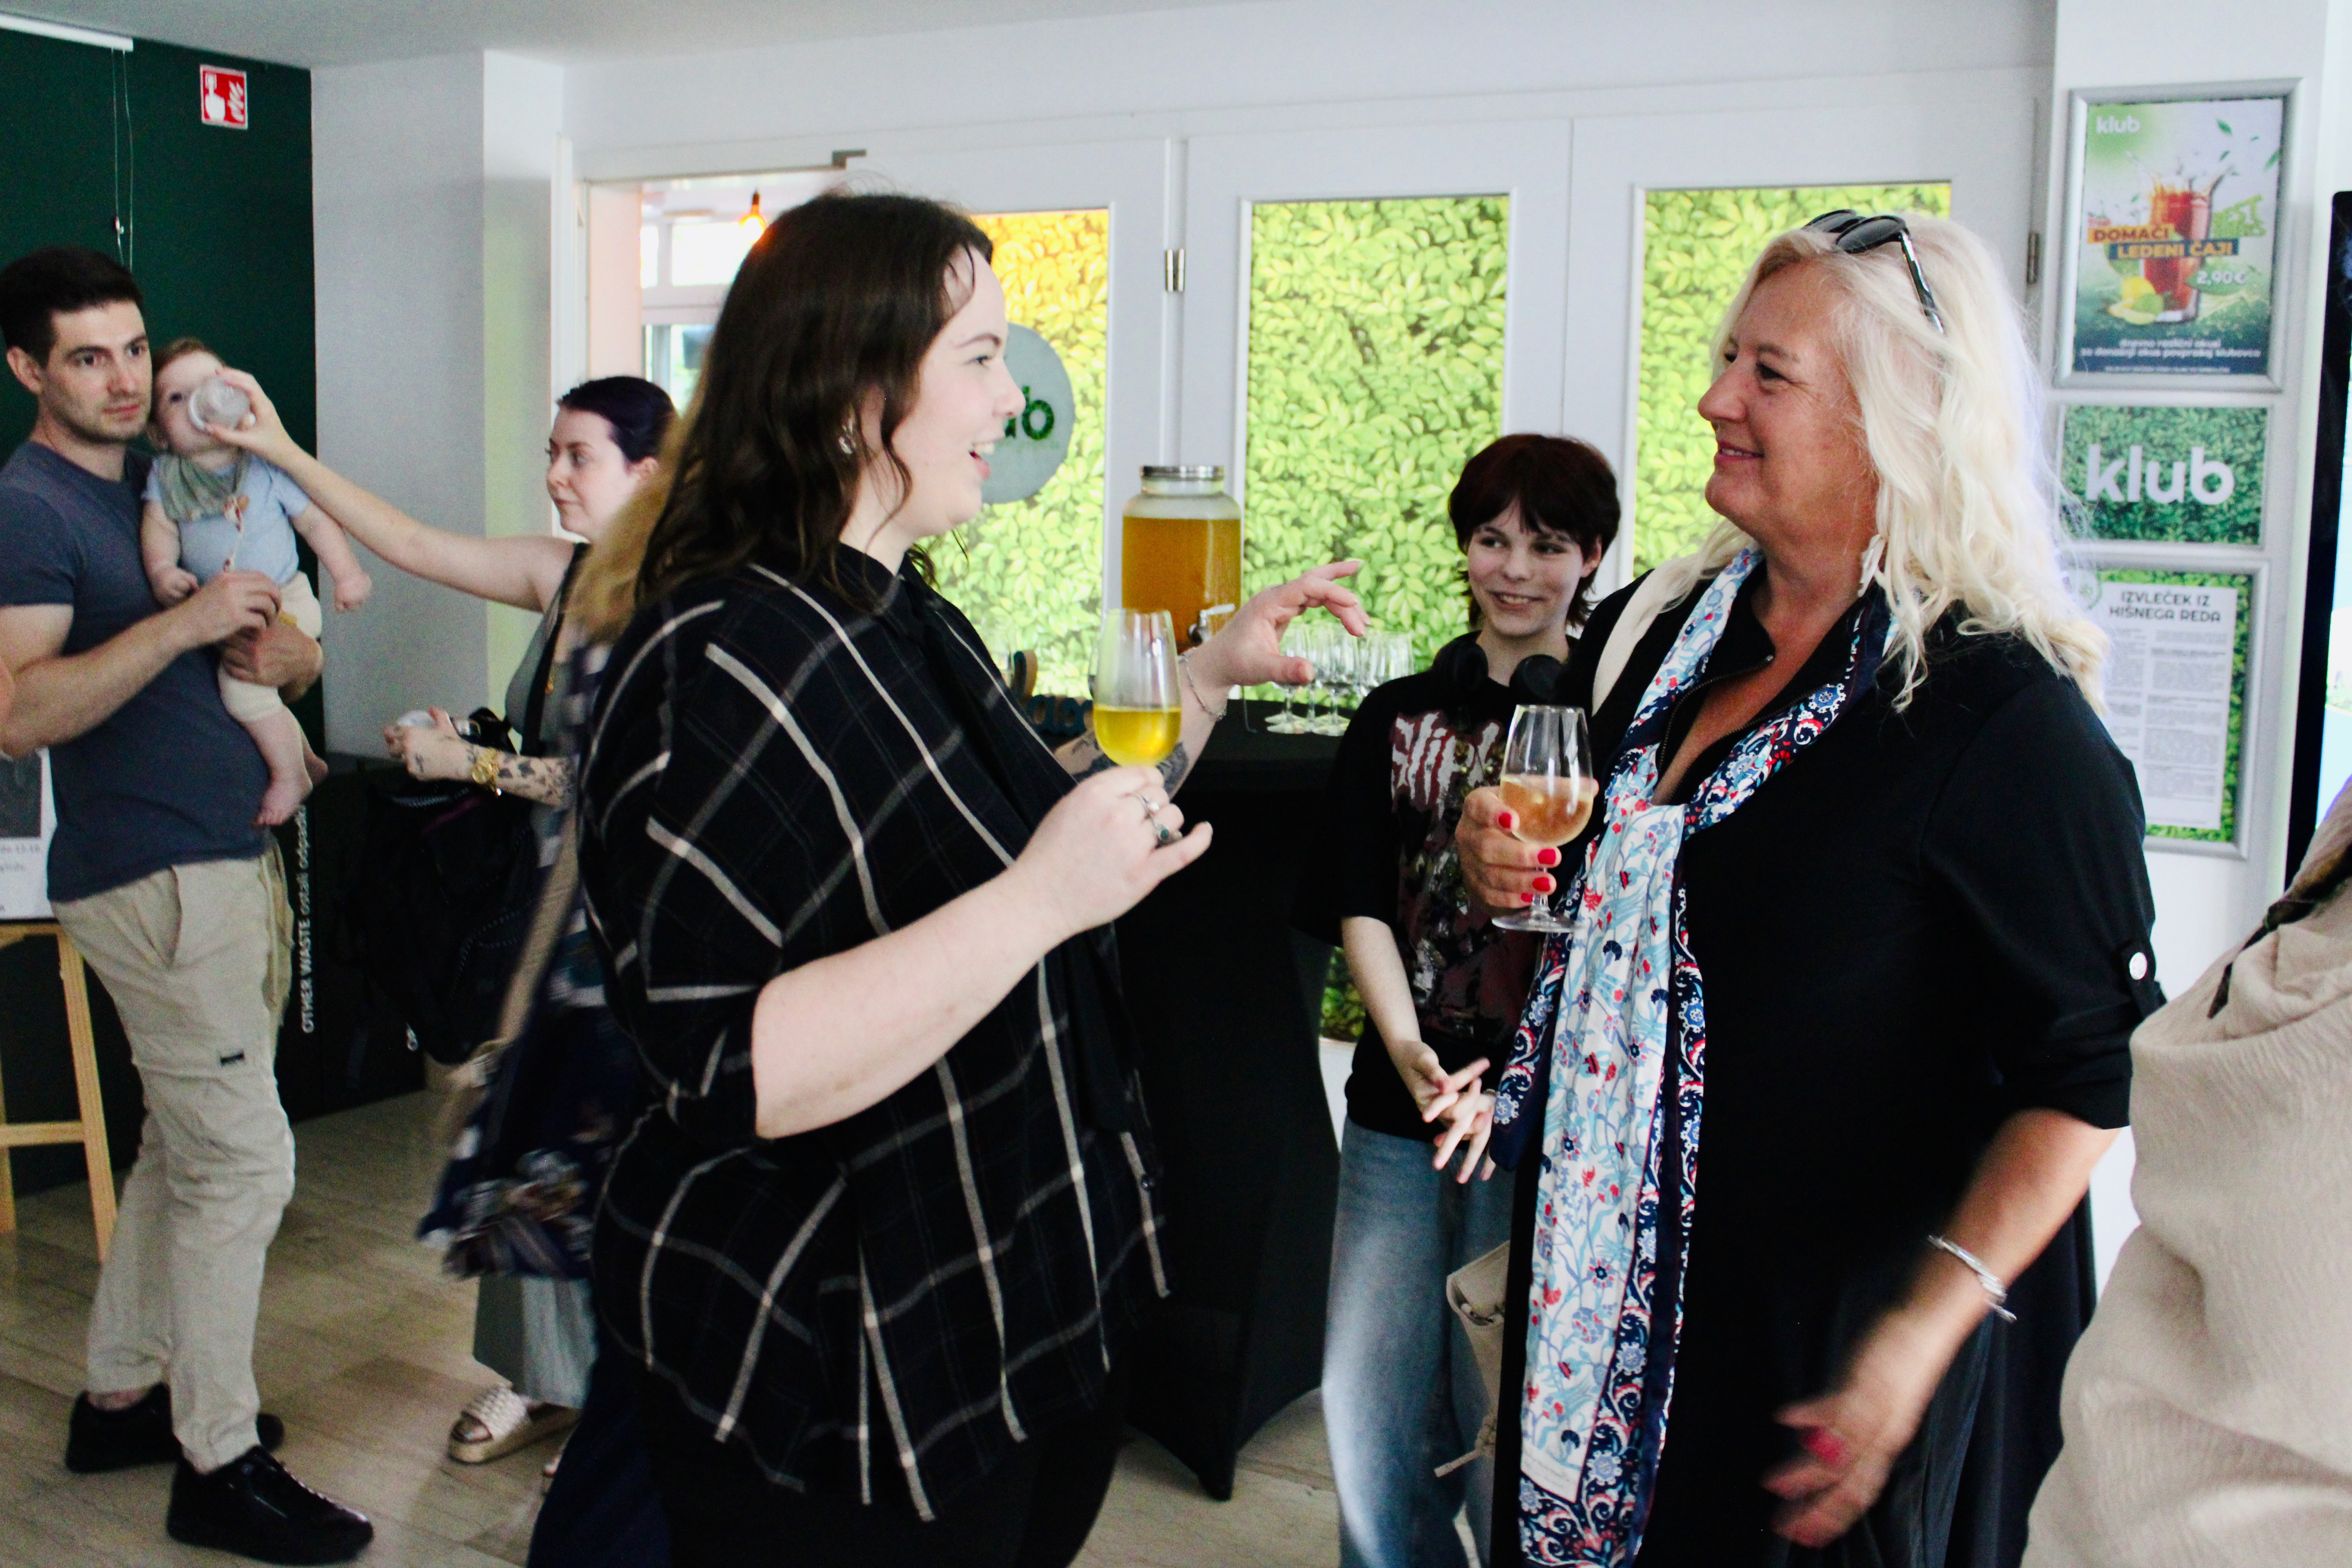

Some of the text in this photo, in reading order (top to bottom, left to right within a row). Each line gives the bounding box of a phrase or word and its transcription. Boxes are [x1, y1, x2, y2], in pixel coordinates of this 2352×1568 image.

[2096, 116, 2140, 134] klub
[2094, 225, 2169, 242] DOMAČI
[2118, 243, 2185, 259] LEDENI
[2086, 444, 2234, 505] klub
[2121, 590, 2211, 607] IZVLEČEK IZ
[2109, 604, 2221, 622] HIŠNEGA REDA
[298, 918, 312, 976] WASTE
